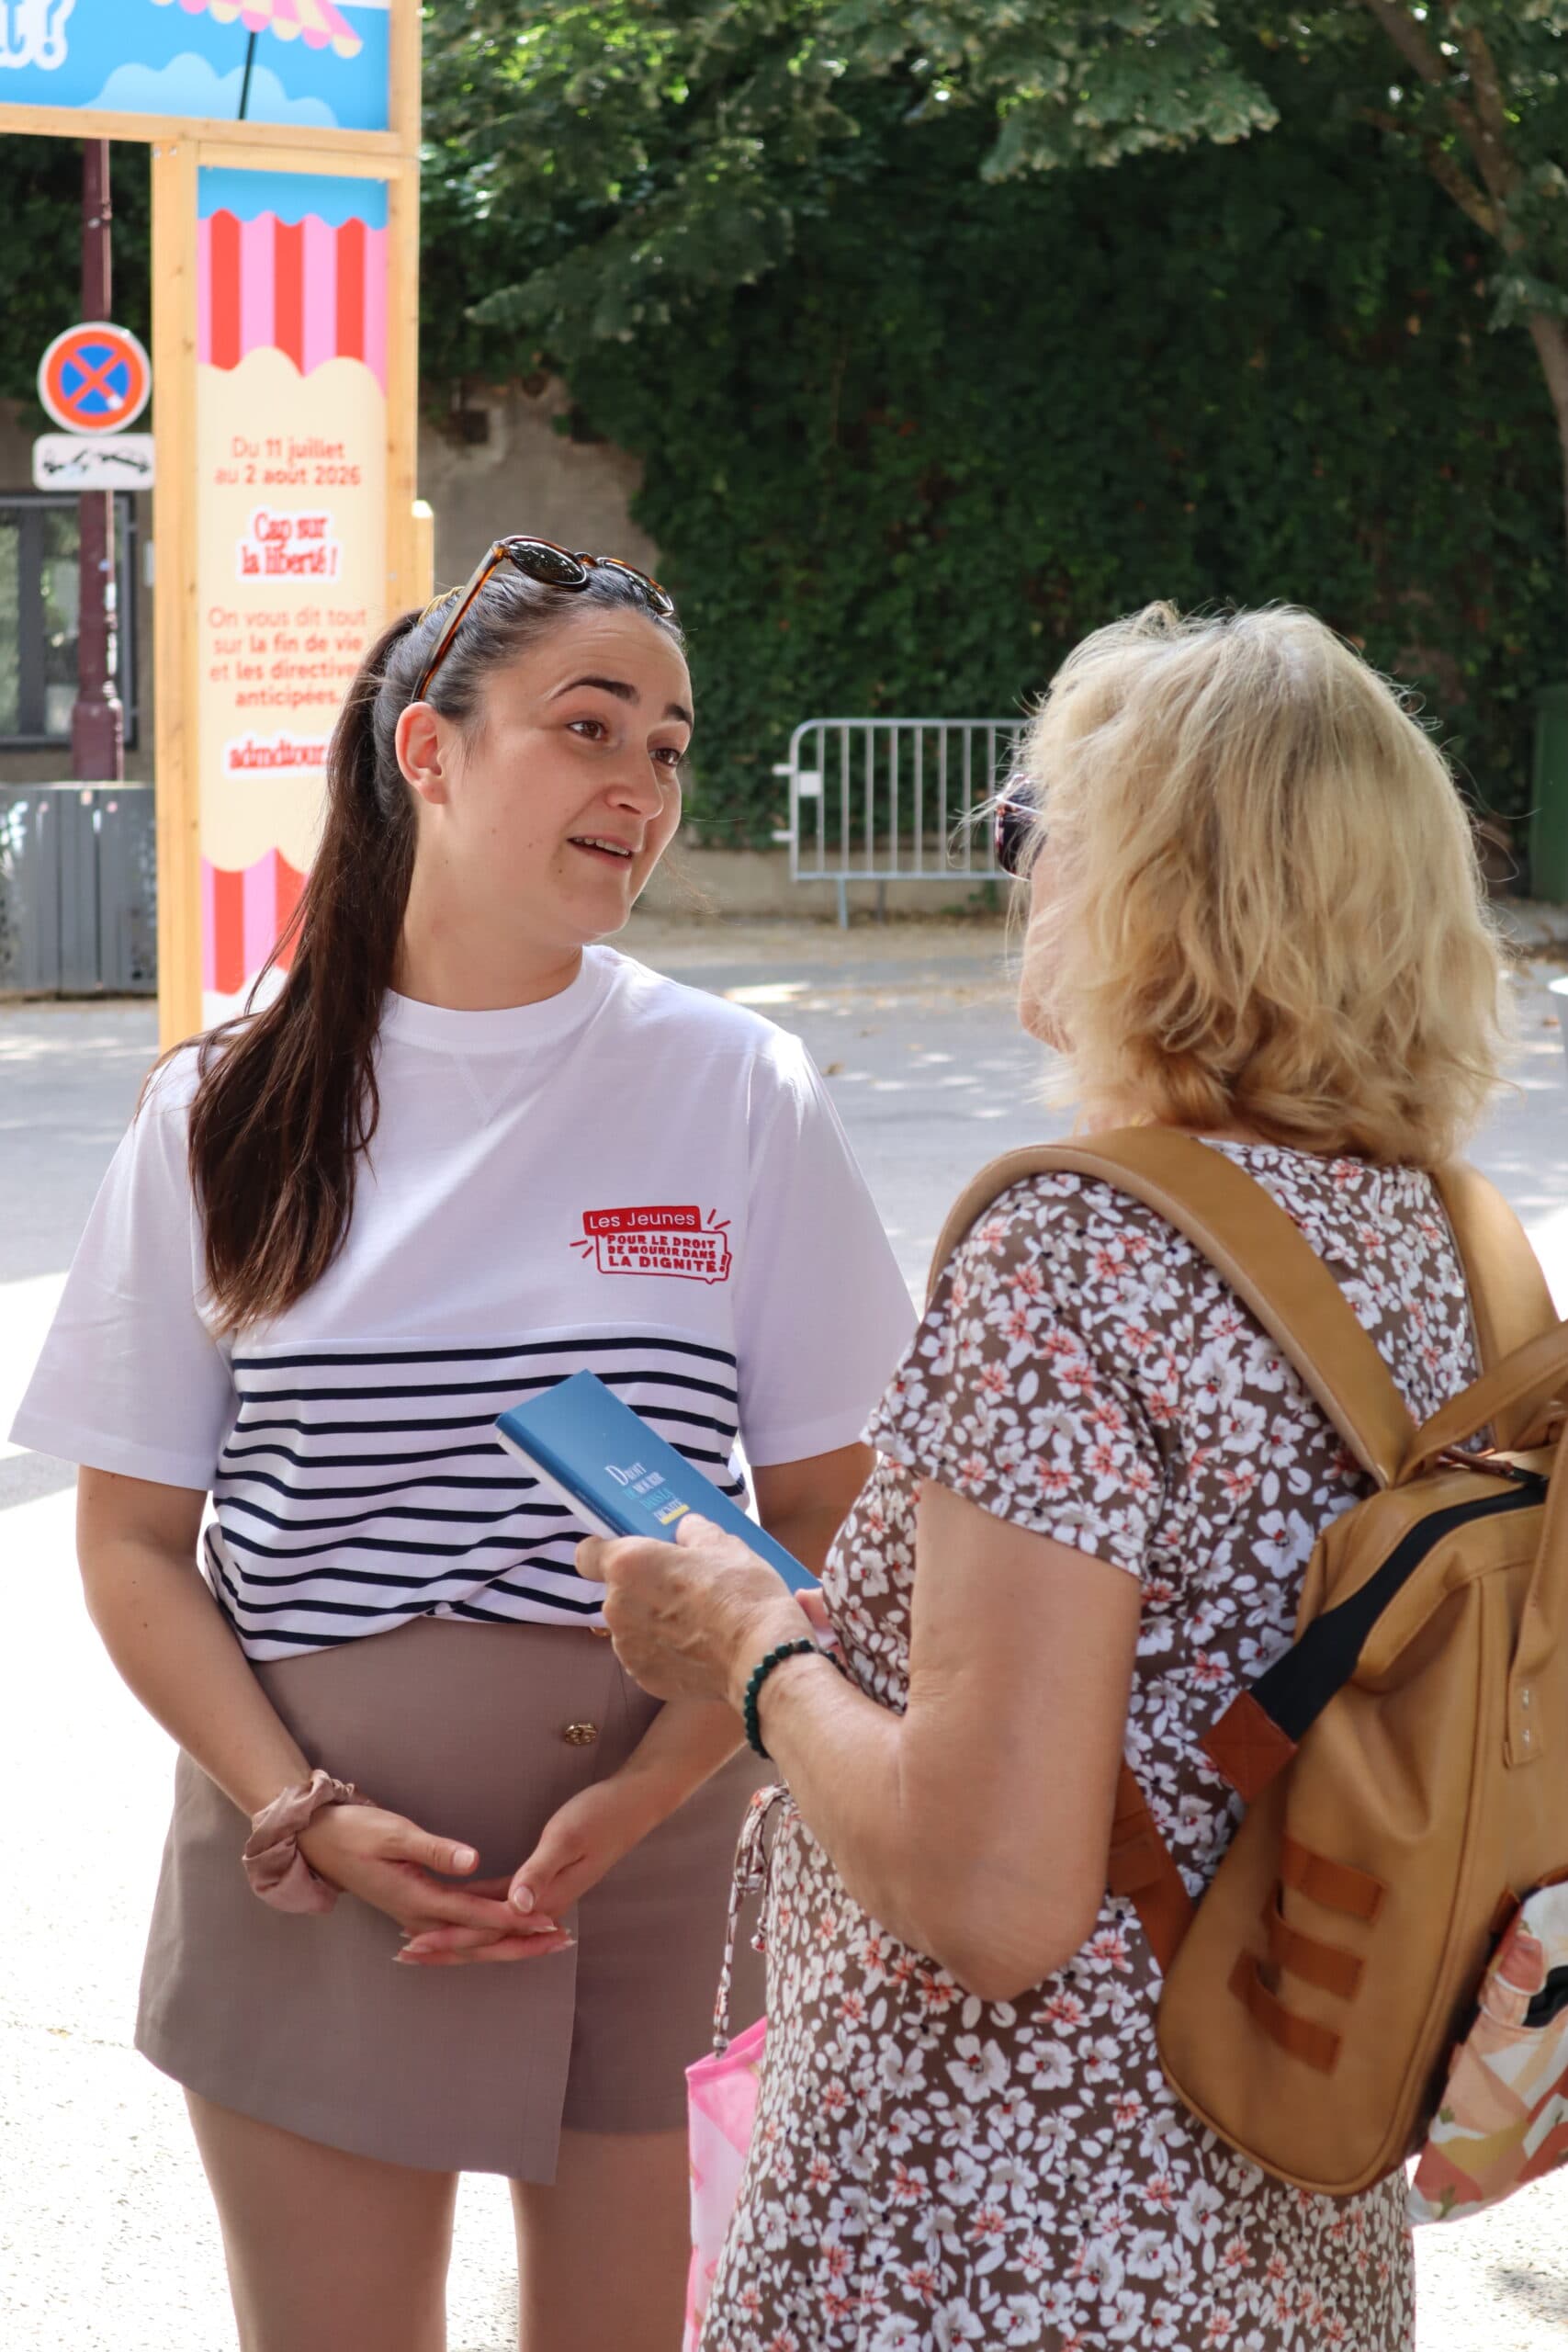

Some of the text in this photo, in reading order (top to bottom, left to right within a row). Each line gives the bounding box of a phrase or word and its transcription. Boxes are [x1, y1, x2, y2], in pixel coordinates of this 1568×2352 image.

[231, 436, 344, 468] Du 11 juillet
[214, 468, 239, 485] au
[245, 463, 255, 485] 2
[315, 465, 361, 485] 2026
[254, 511, 292, 551] Cap
[209, 605, 367, 628] On vous dit tout
[213, 631, 363, 655] sur la fin de vie
[209, 656, 361, 682] et les directive
[589, 1212, 695, 1229] Les Jeunes
[607, 1234, 716, 1250] POUR LE DROIT
[607, 1245, 716, 1259] DE MOURIR DANS
[608, 1255, 632, 1268] LA
